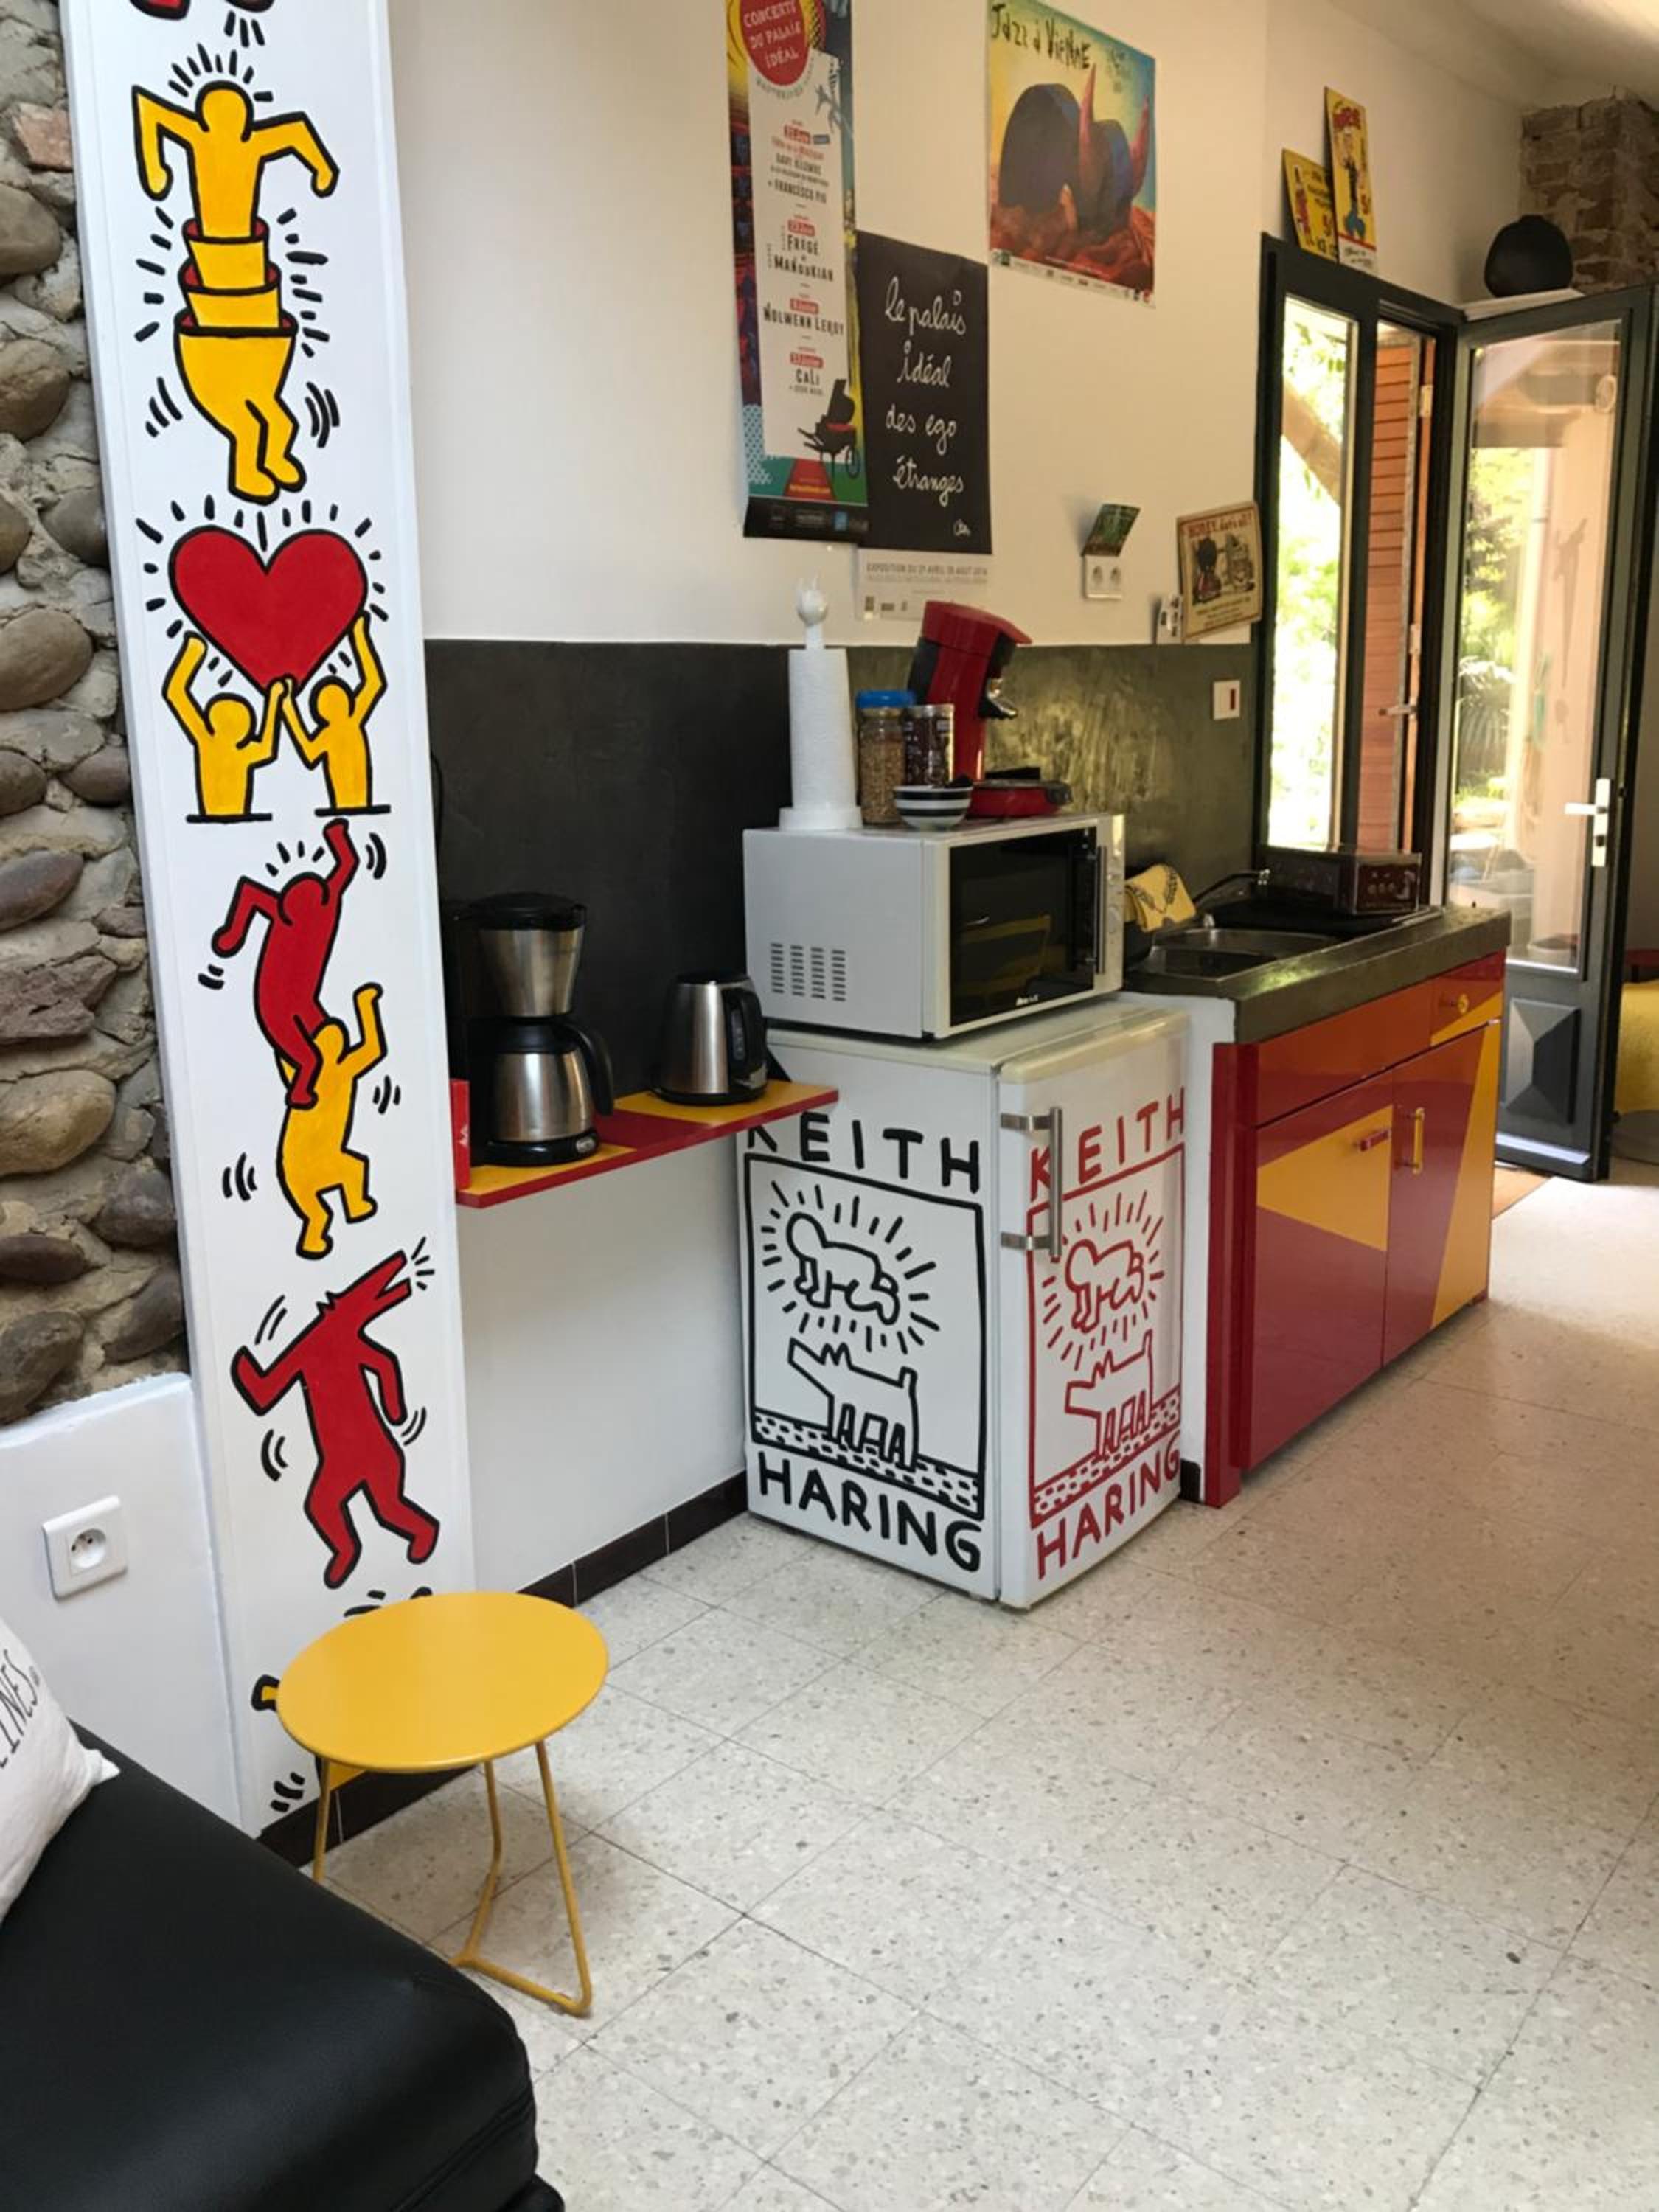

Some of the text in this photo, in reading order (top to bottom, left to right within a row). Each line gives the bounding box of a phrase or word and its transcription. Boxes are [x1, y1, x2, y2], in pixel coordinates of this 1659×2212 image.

[743, 0, 796, 27] CONCERTS
[750, 21, 801, 49] DU PALAIS
[909, 289, 967, 336] palais
[897, 339, 951, 388] idéal
[886, 403, 957, 456] des ego
[892, 455, 964, 508] étranges
[1031, 1085, 1184, 1202] KEITH
[758, 1451, 983, 1572] HARING
[1037, 1429, 1180, 1580] HARING
